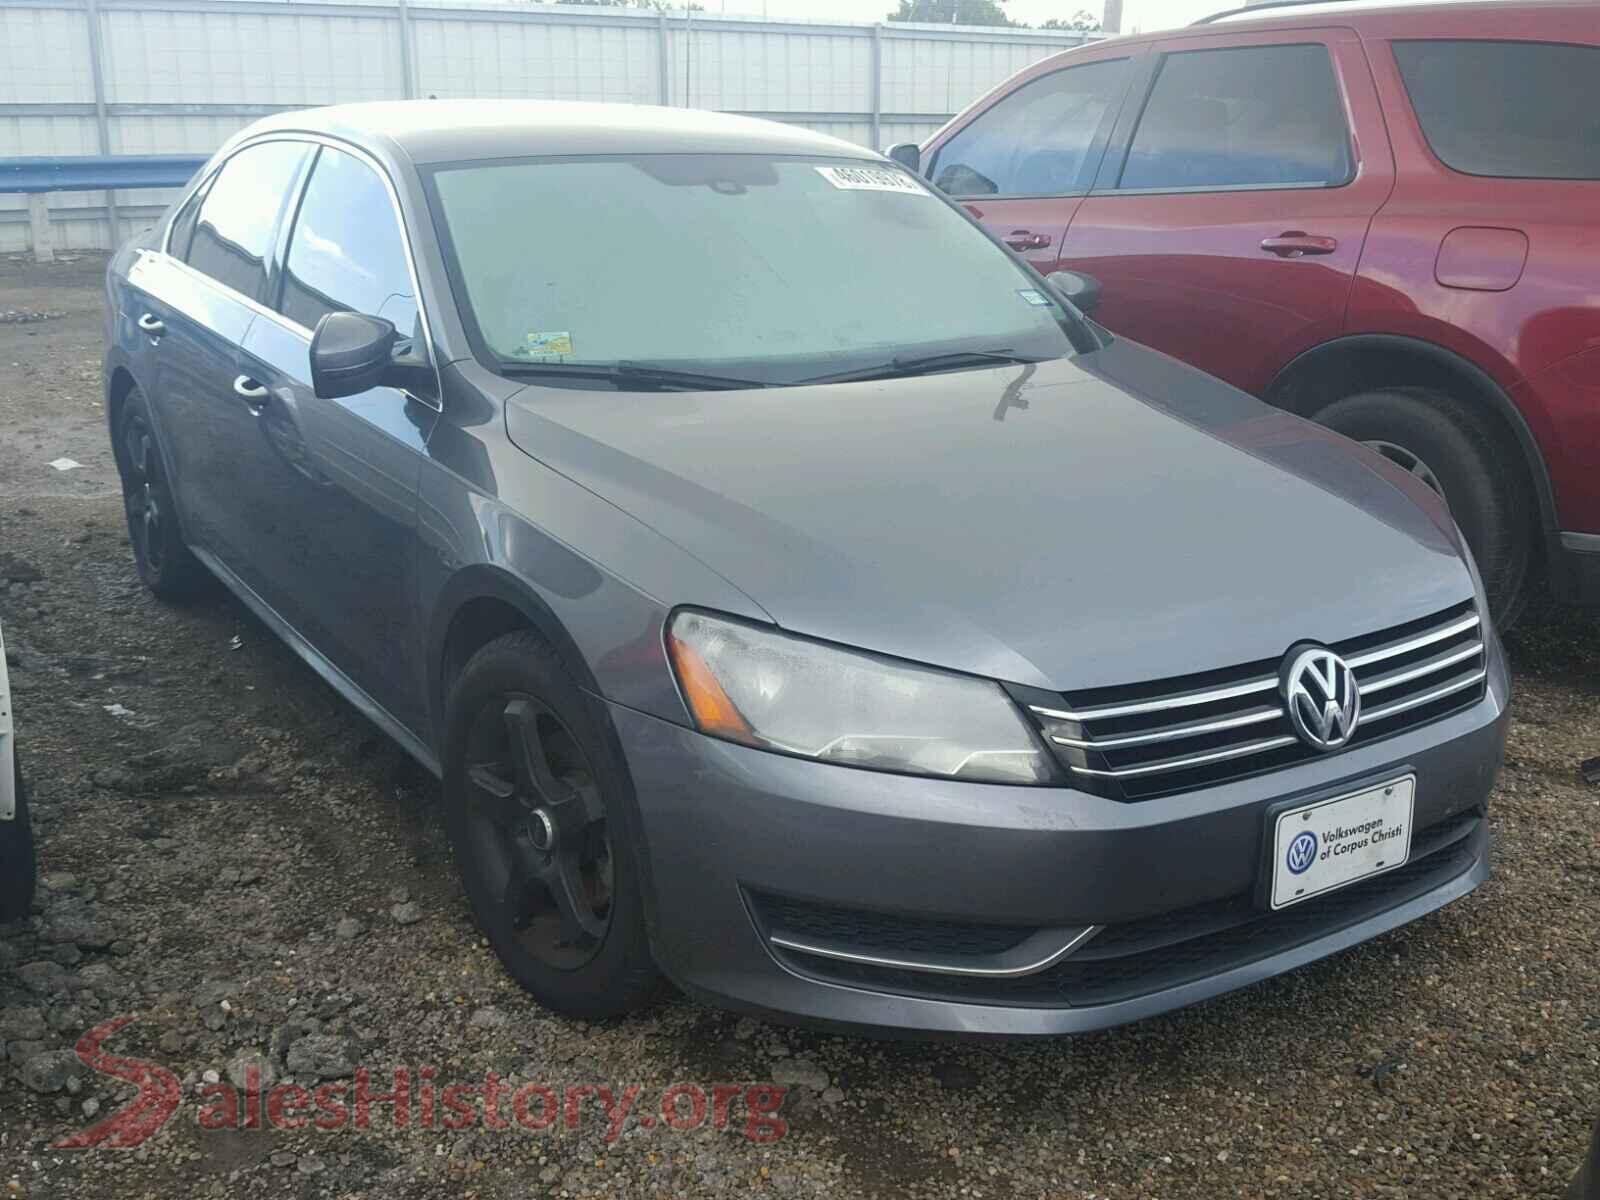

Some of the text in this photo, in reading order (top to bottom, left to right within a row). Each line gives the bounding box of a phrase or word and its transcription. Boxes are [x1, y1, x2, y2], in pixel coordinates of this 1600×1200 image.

[1320, 824, 1403, 861] of Corpus Christi
[1322, 818, 1383, 844] Volkswagen
